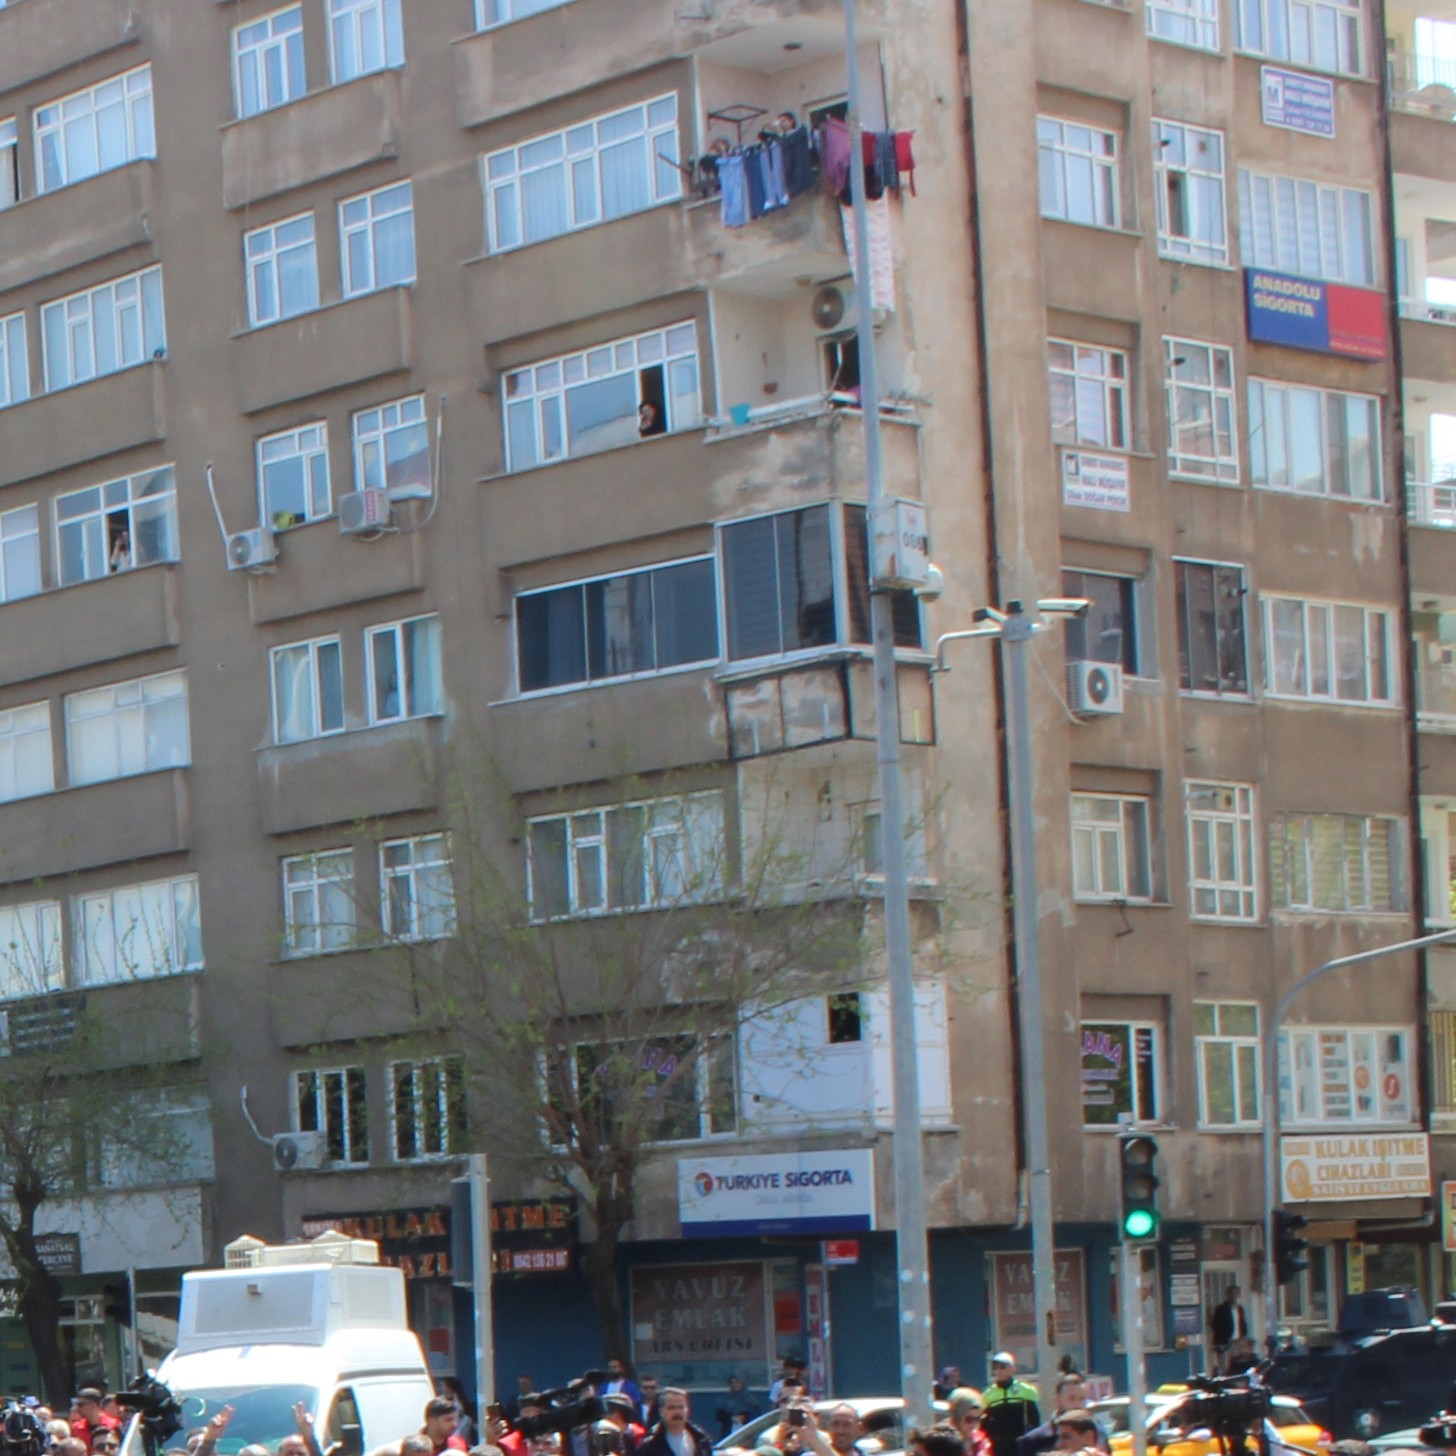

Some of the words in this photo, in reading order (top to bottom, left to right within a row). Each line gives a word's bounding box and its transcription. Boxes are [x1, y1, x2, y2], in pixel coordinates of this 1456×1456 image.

[1253, 274, 1321, 301] ANADOLU
[1253, 290, 1316, 318] SİGORTA
[1315, 1139, 1369, 1159] KULAK
[785, 1168, 852, 1187] SİGORTA
[653, 1276, 747, 1300] YAVUZ
[654, 1306, 747, 1331] EMLAK
